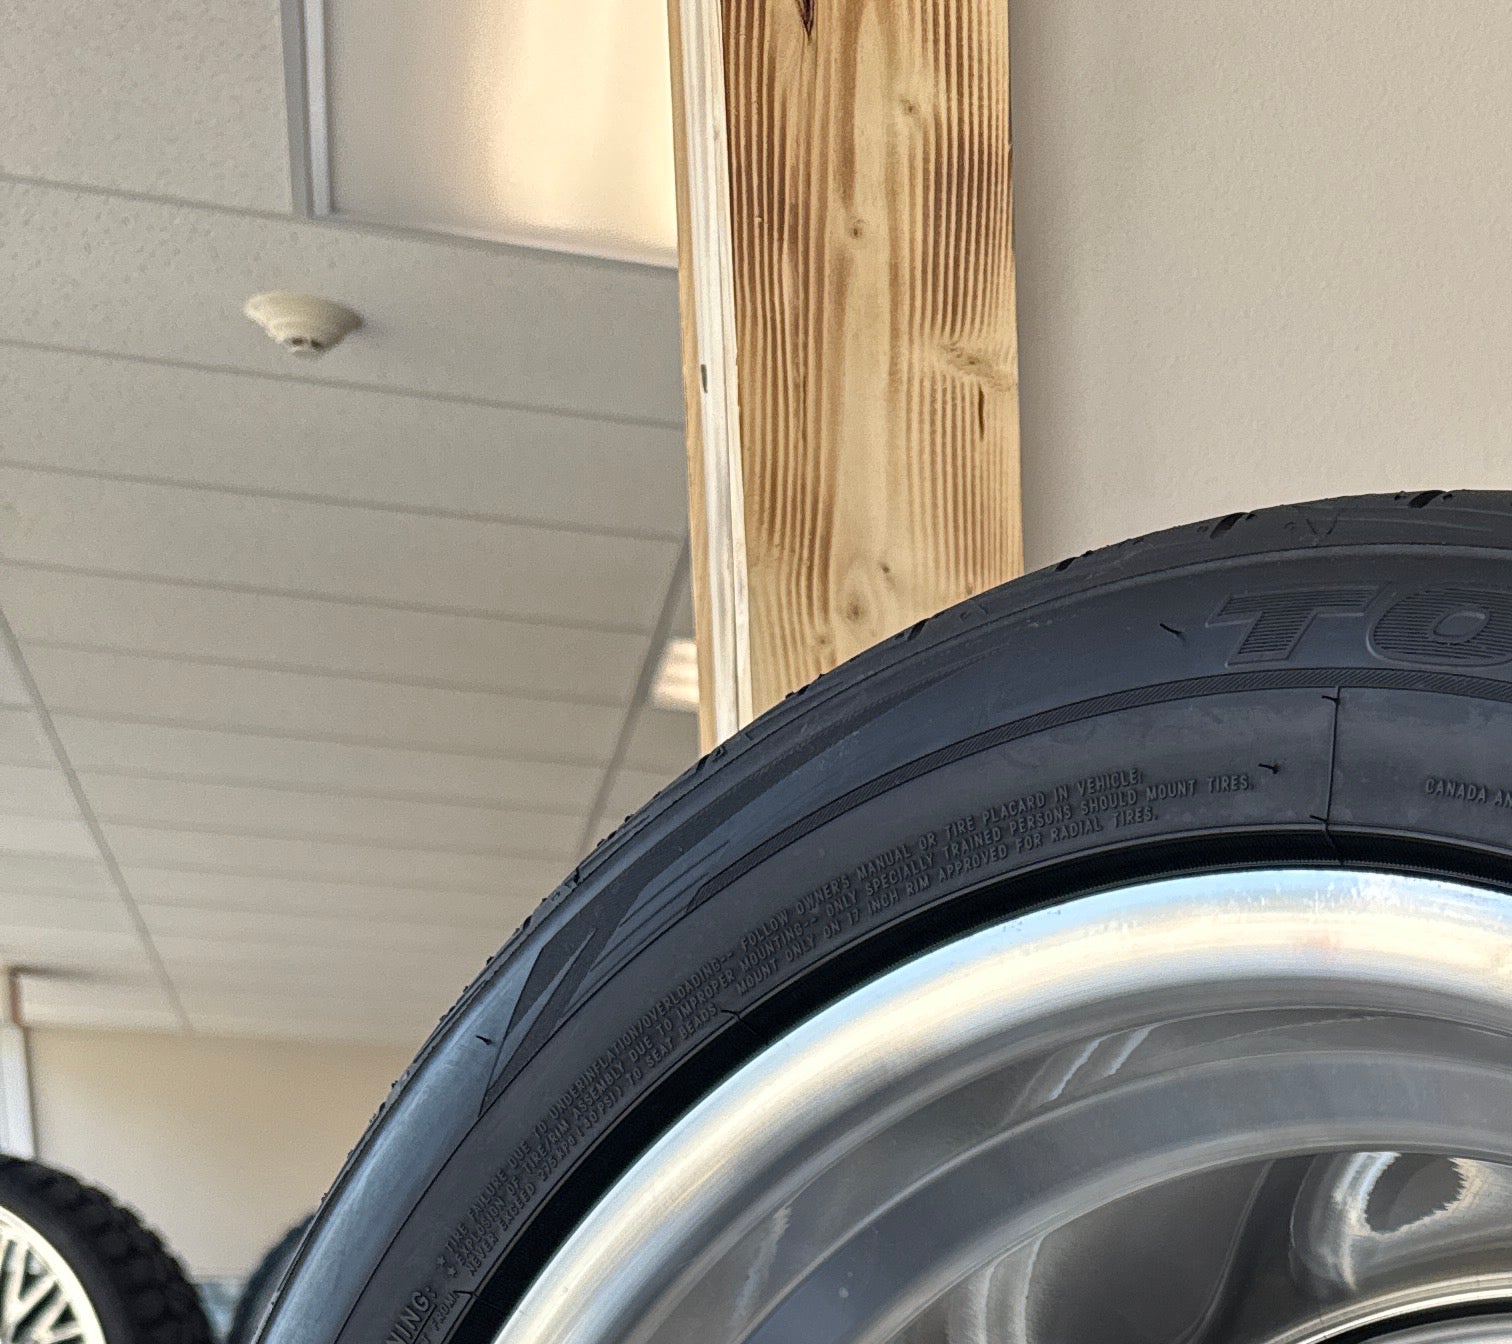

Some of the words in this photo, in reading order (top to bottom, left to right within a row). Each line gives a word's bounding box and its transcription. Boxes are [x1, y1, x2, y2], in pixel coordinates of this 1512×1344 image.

[739, 910, 791, 952] FOLLOW
[855, 843, 911, 882] MANUAL
[918, 831, 937, 851] OR
[944, 816, 975, 840] TIRE
[981, 791, 1046, 827] PLACARD
[1053, 784, 1070, 804] IN
[1424, 775, 1487, 803] CANADA
[627, 1035, 654, 1064] DUE
[655, 1016, 675, 1038] TO
[674, 966, 737, 1023] IMPROPER
[823, 888, 860, 919] ONLY
[864, 851, 936, 898] SPECIALLY
[942, 826, 1002, 861] TRAINED
[1009, 803, 1073, 837] PERSONS
[1080, 788, 1138, 816] SHOULD
[1146, 779, 1197, 803] MOUNT
[1207, 774, 1254, 795] TIRES.
[734, 955, 780, 996] MOUNT
[782, 933, 817, 964] ONLY
[820, 918, 842, 940] ON
[845, 907, 862, 926] 17
[866, 887, 900, 916] INCH
[904, 872, 931, 897] RIM
[937, 841, 1008, 883] APPROVED
[1014, 831, 1043, 854] FOR
[1049, 815, 1103, 844] RADIAL
[1111, 804, 1158, 829] TIRES.
